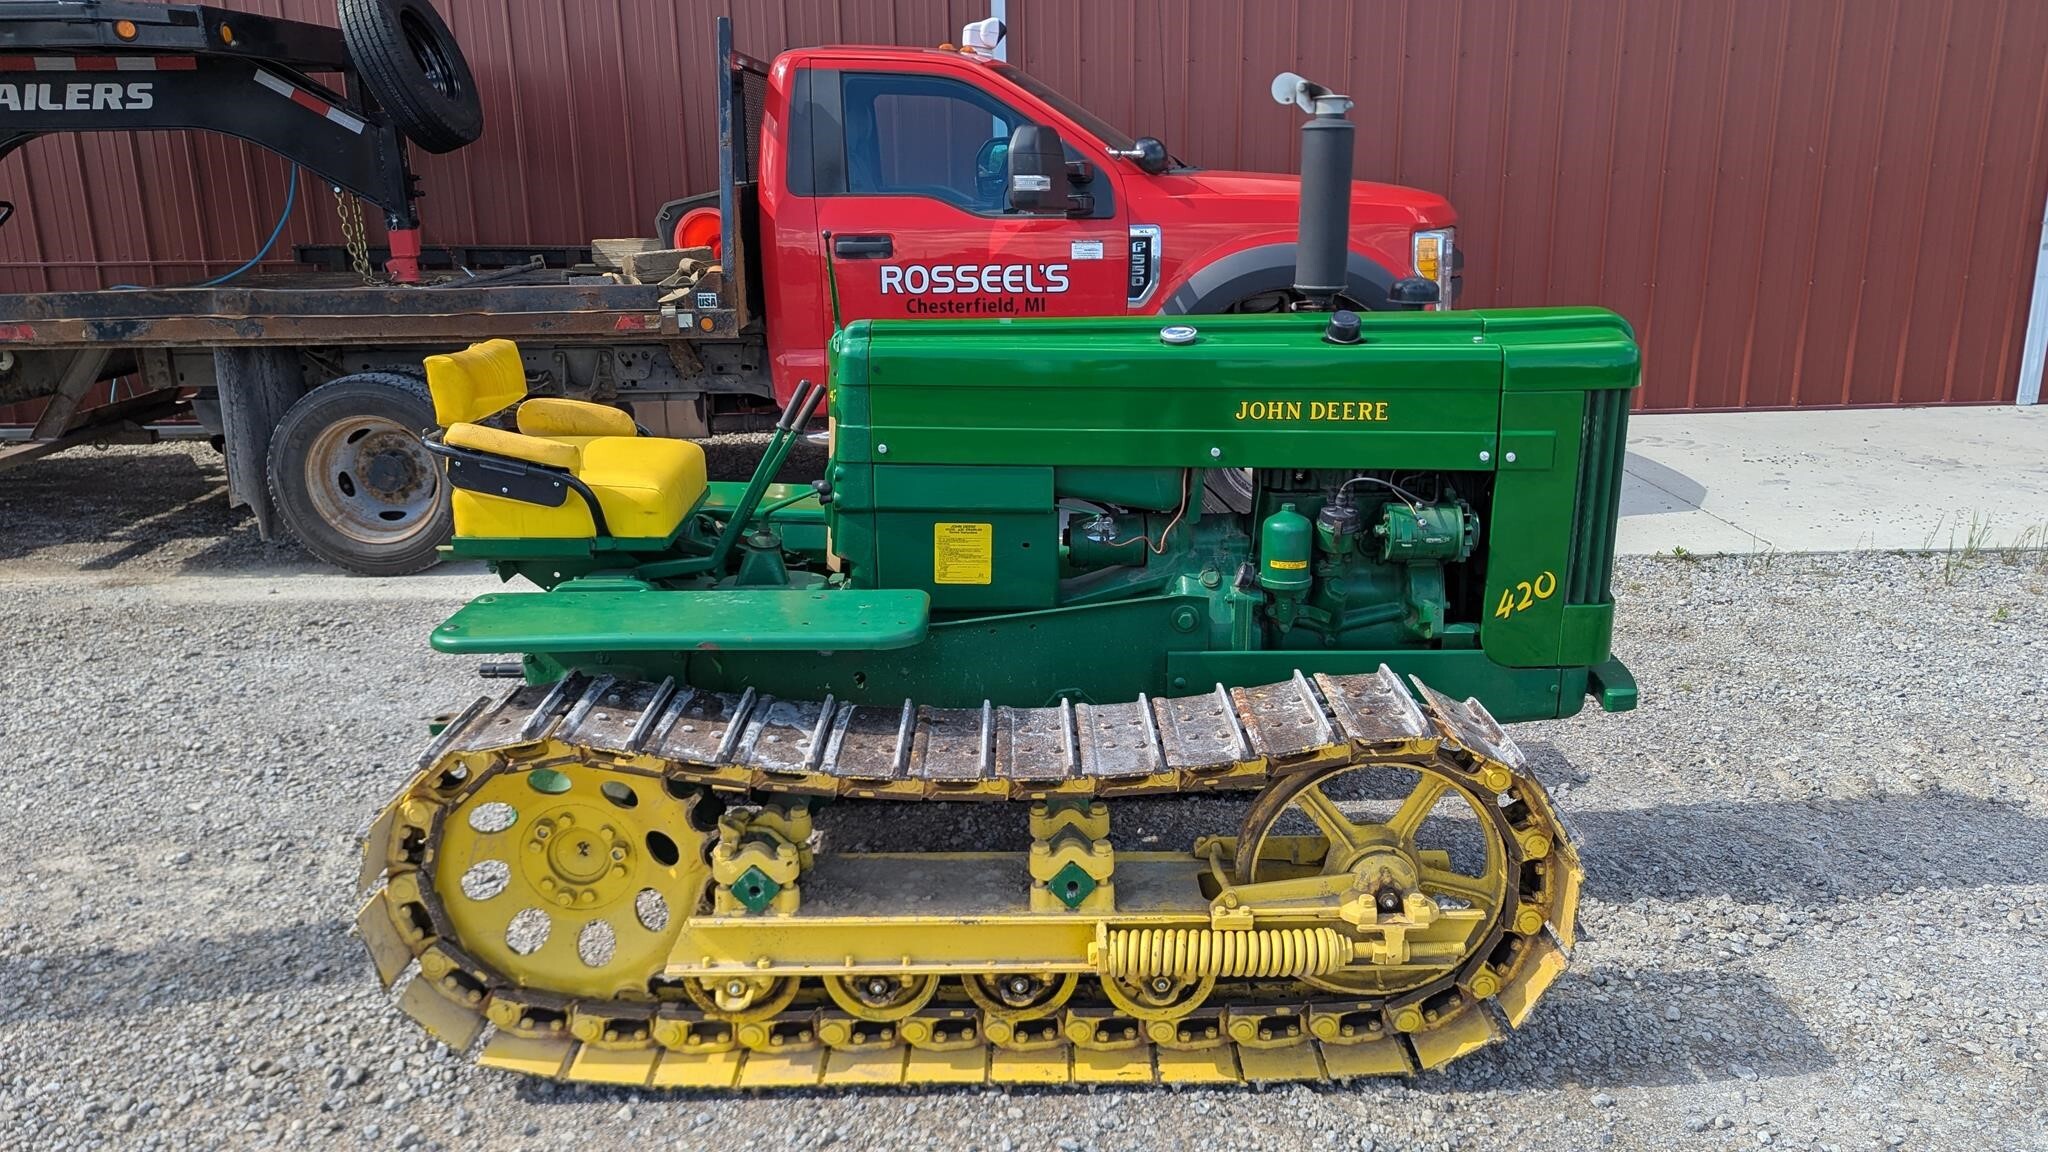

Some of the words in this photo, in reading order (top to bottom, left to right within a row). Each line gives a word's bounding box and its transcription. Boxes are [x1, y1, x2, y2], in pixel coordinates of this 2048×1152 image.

[0, 83, 154, 111] AILERS
[1131, 241, 1146, 287] F550
[880, 264, 1070, 295] ROSSEEL'S
[699, 298, 717, 306] USA
[906, 297, 1020, 316] Chesterfield,
[1025, 297, 1046, 313] MI
[1235, 401, 1302, 421] JOHN
[1309, 401, 1389, 421] DEERE
[1495, 571, 1556, 619] 420
